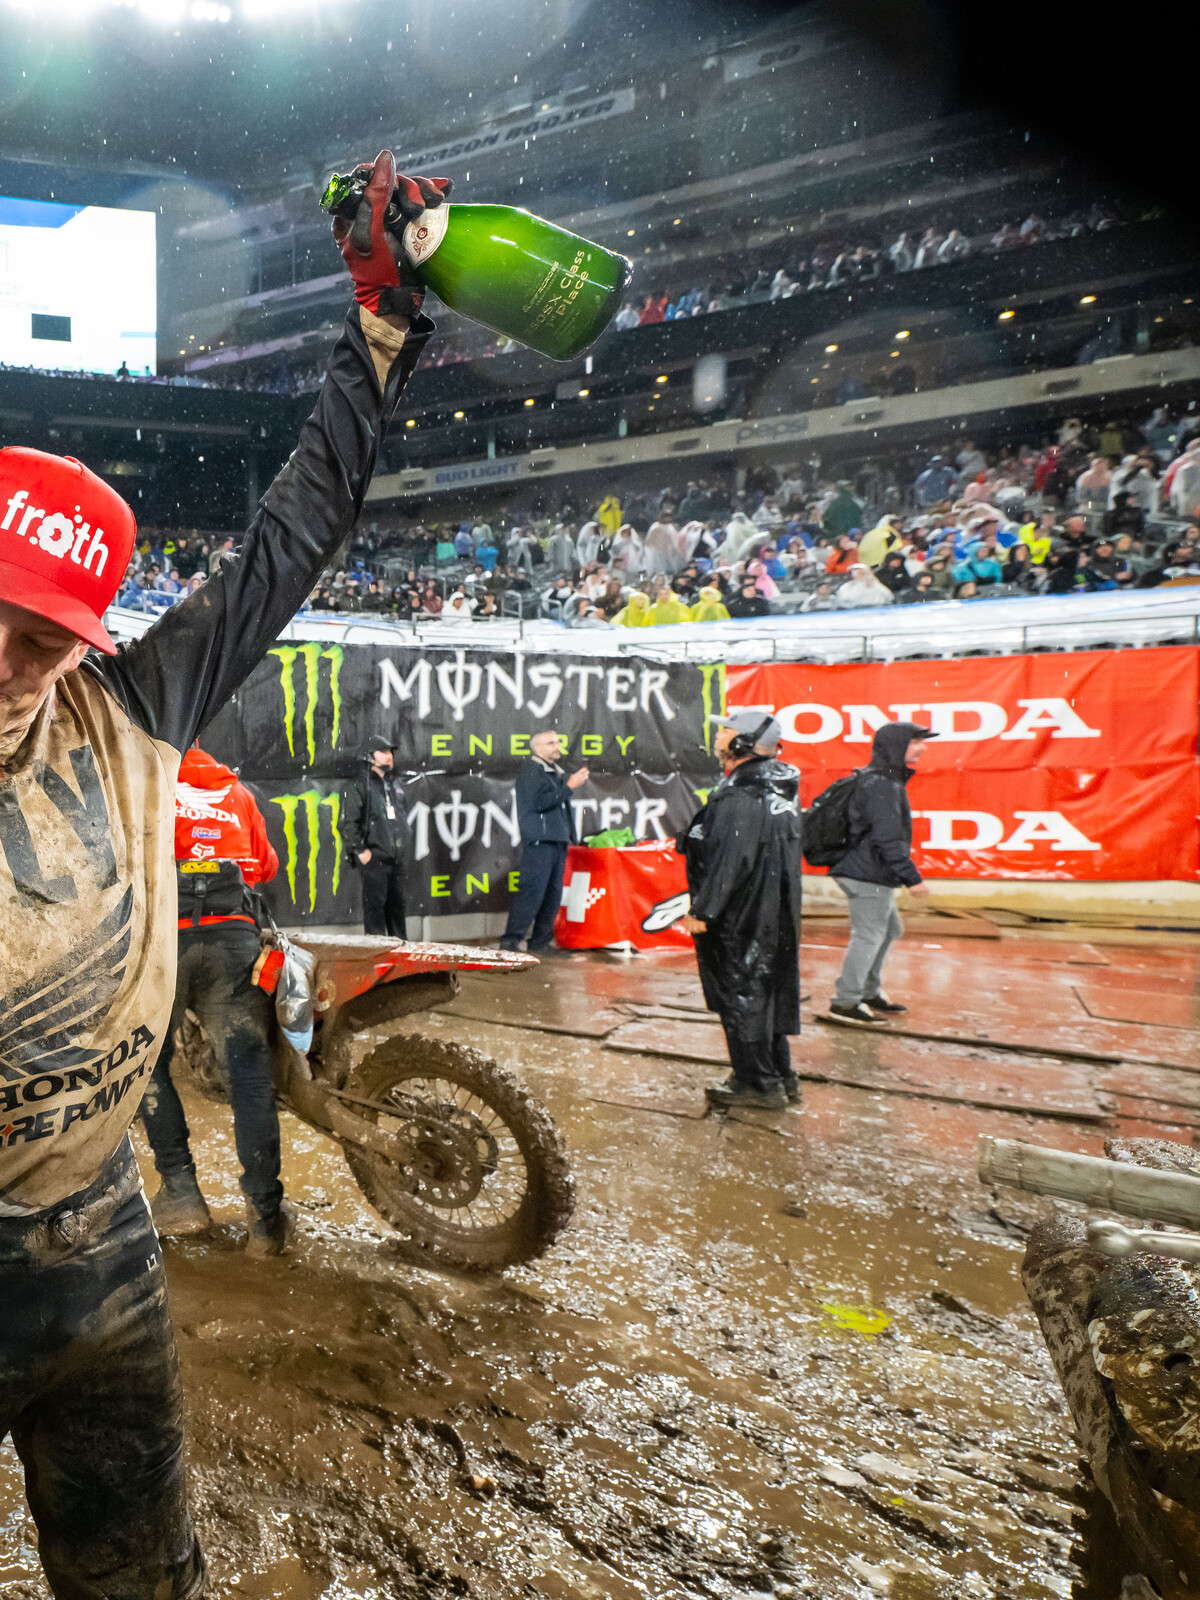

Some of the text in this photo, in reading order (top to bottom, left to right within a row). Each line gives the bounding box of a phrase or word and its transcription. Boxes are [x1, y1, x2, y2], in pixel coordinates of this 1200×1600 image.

[554, 270, 590, 316] Place
[559, 249, 586, 290] Class
[0, 489, 109, 578] froth
[378, 650, 676, 721] MONSTER
[406, 789, 669, 862] MONTER
[431, 871, 521, 898] ENE
